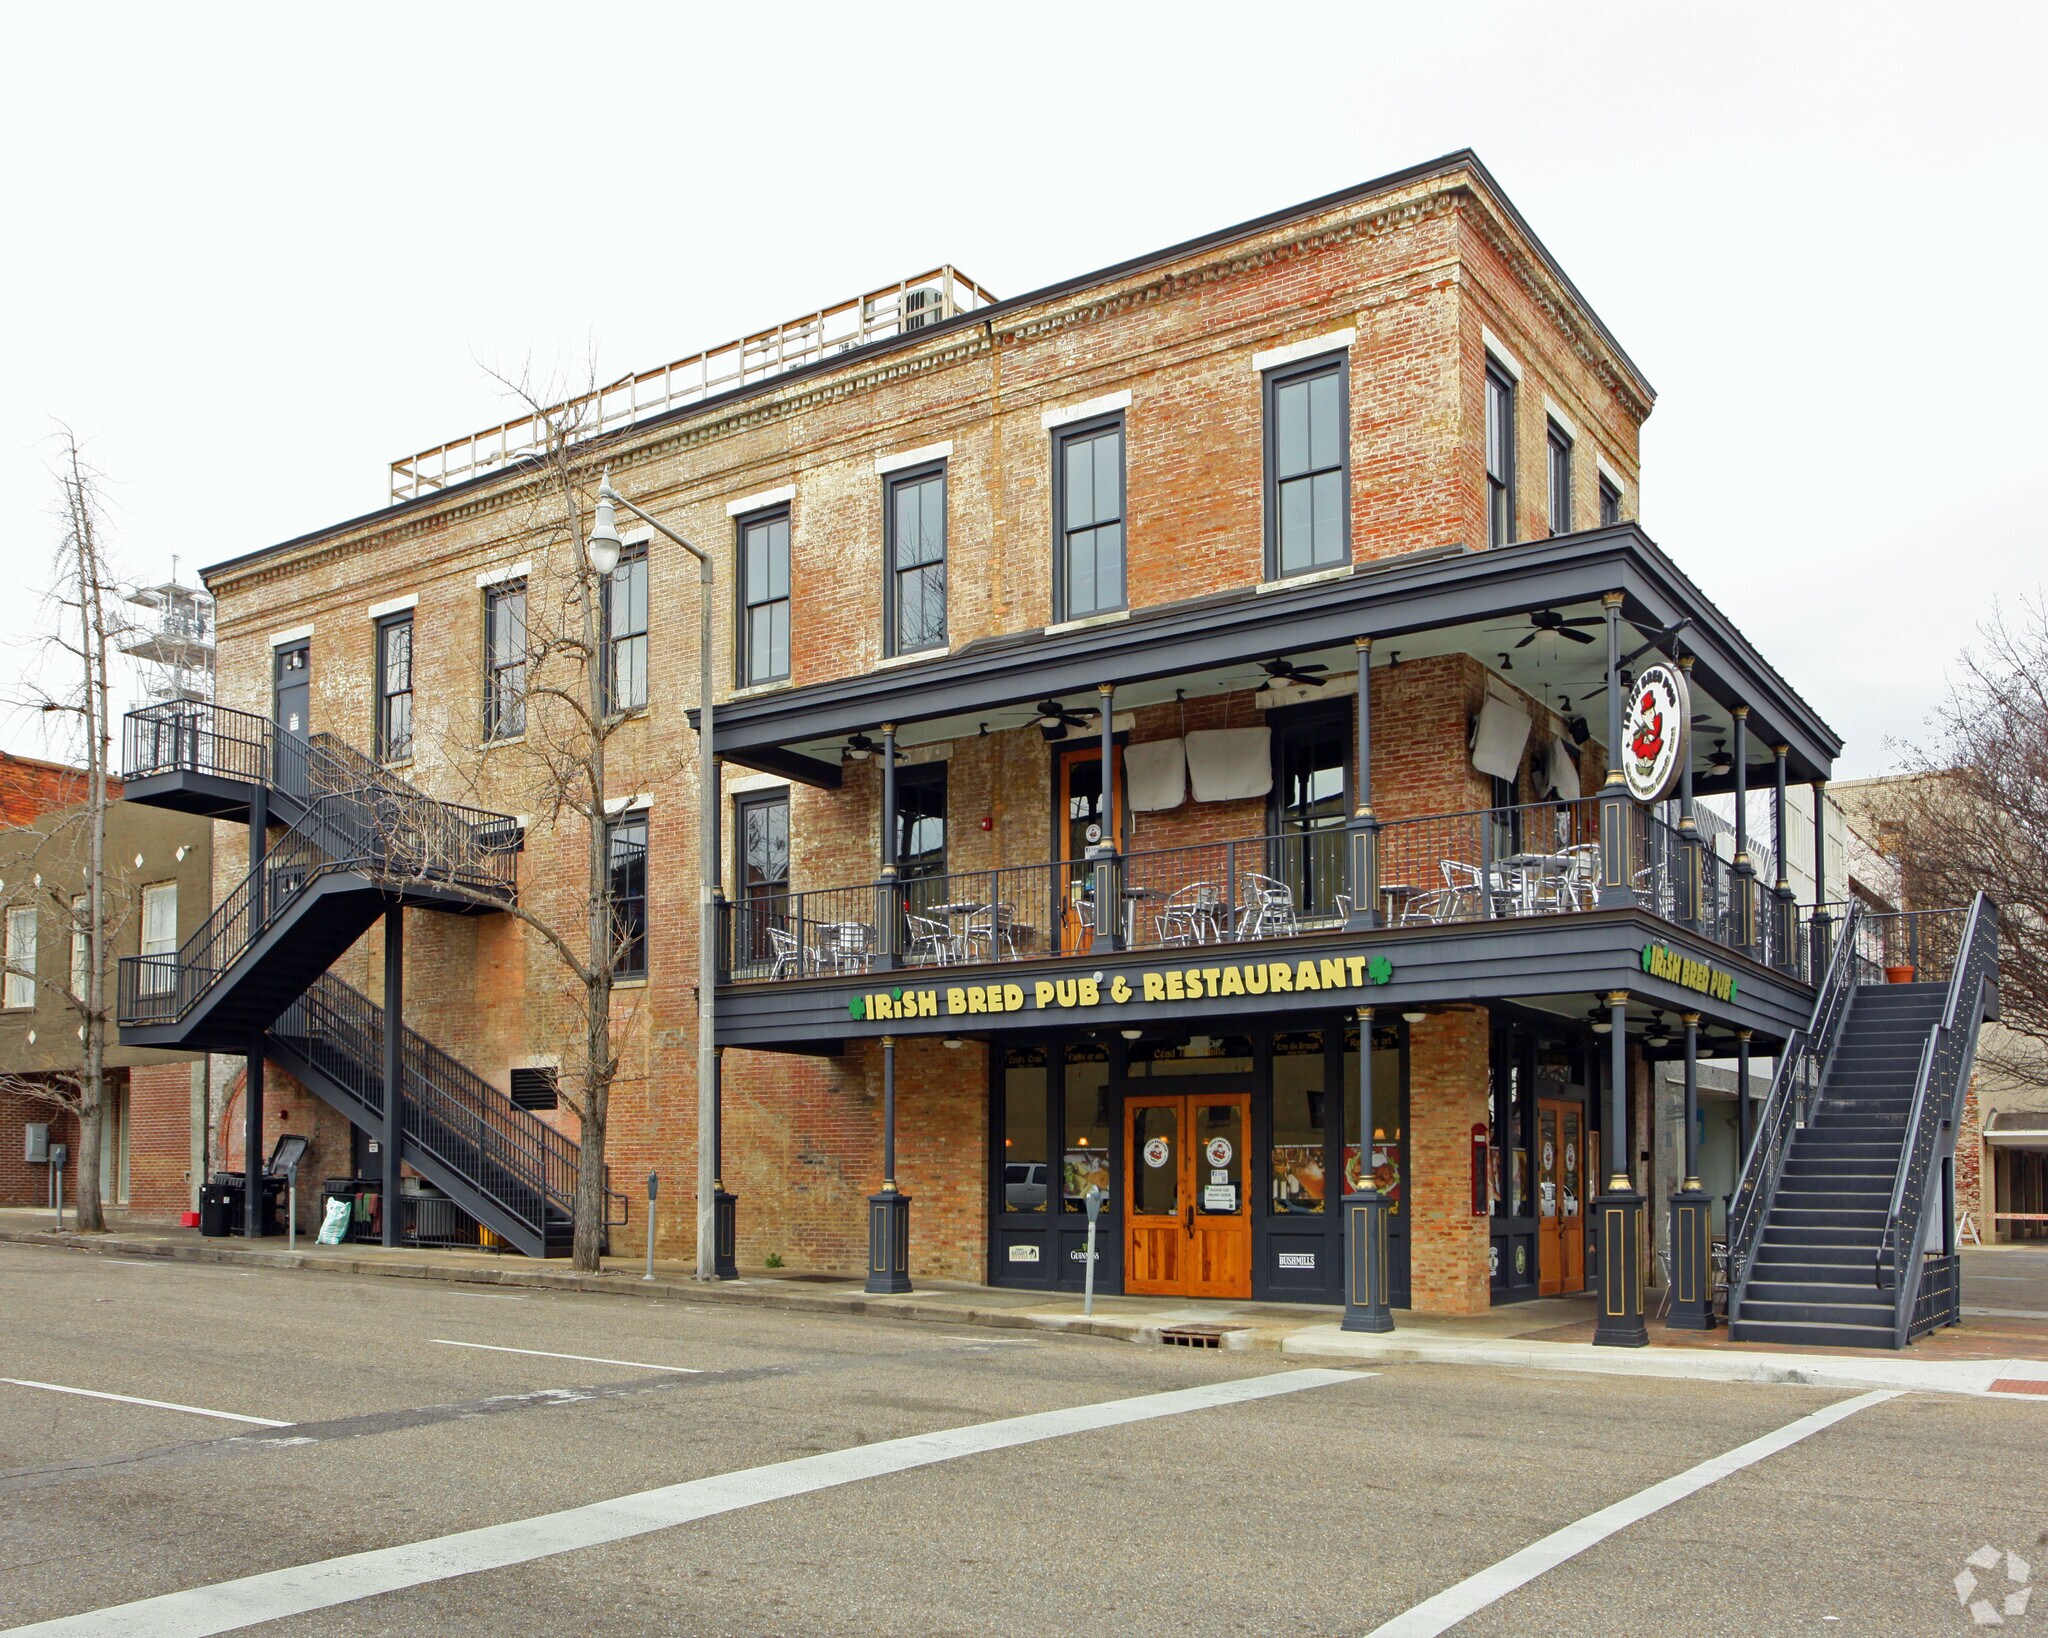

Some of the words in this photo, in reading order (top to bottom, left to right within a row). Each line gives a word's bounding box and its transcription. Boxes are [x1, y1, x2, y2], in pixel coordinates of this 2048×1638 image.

[1623, 683, 1641, 730] IRISH
[1641, 669, 1664, 690] BRED
[1662, 676, 1676, 708] PUB
[947, 983, 1024, 1015] BRED
[1035, 975, 1101, 1009] PUB
[1110, 975, 1133, 1004] &
[1143, 955, 1366, 1001] RESTAURANT
[1681, 957, 1711, 993] BRED
[1709, 968, 1732, 1002] PUB
[1279, 1256, 1315, 1266] BUSHMILLS
